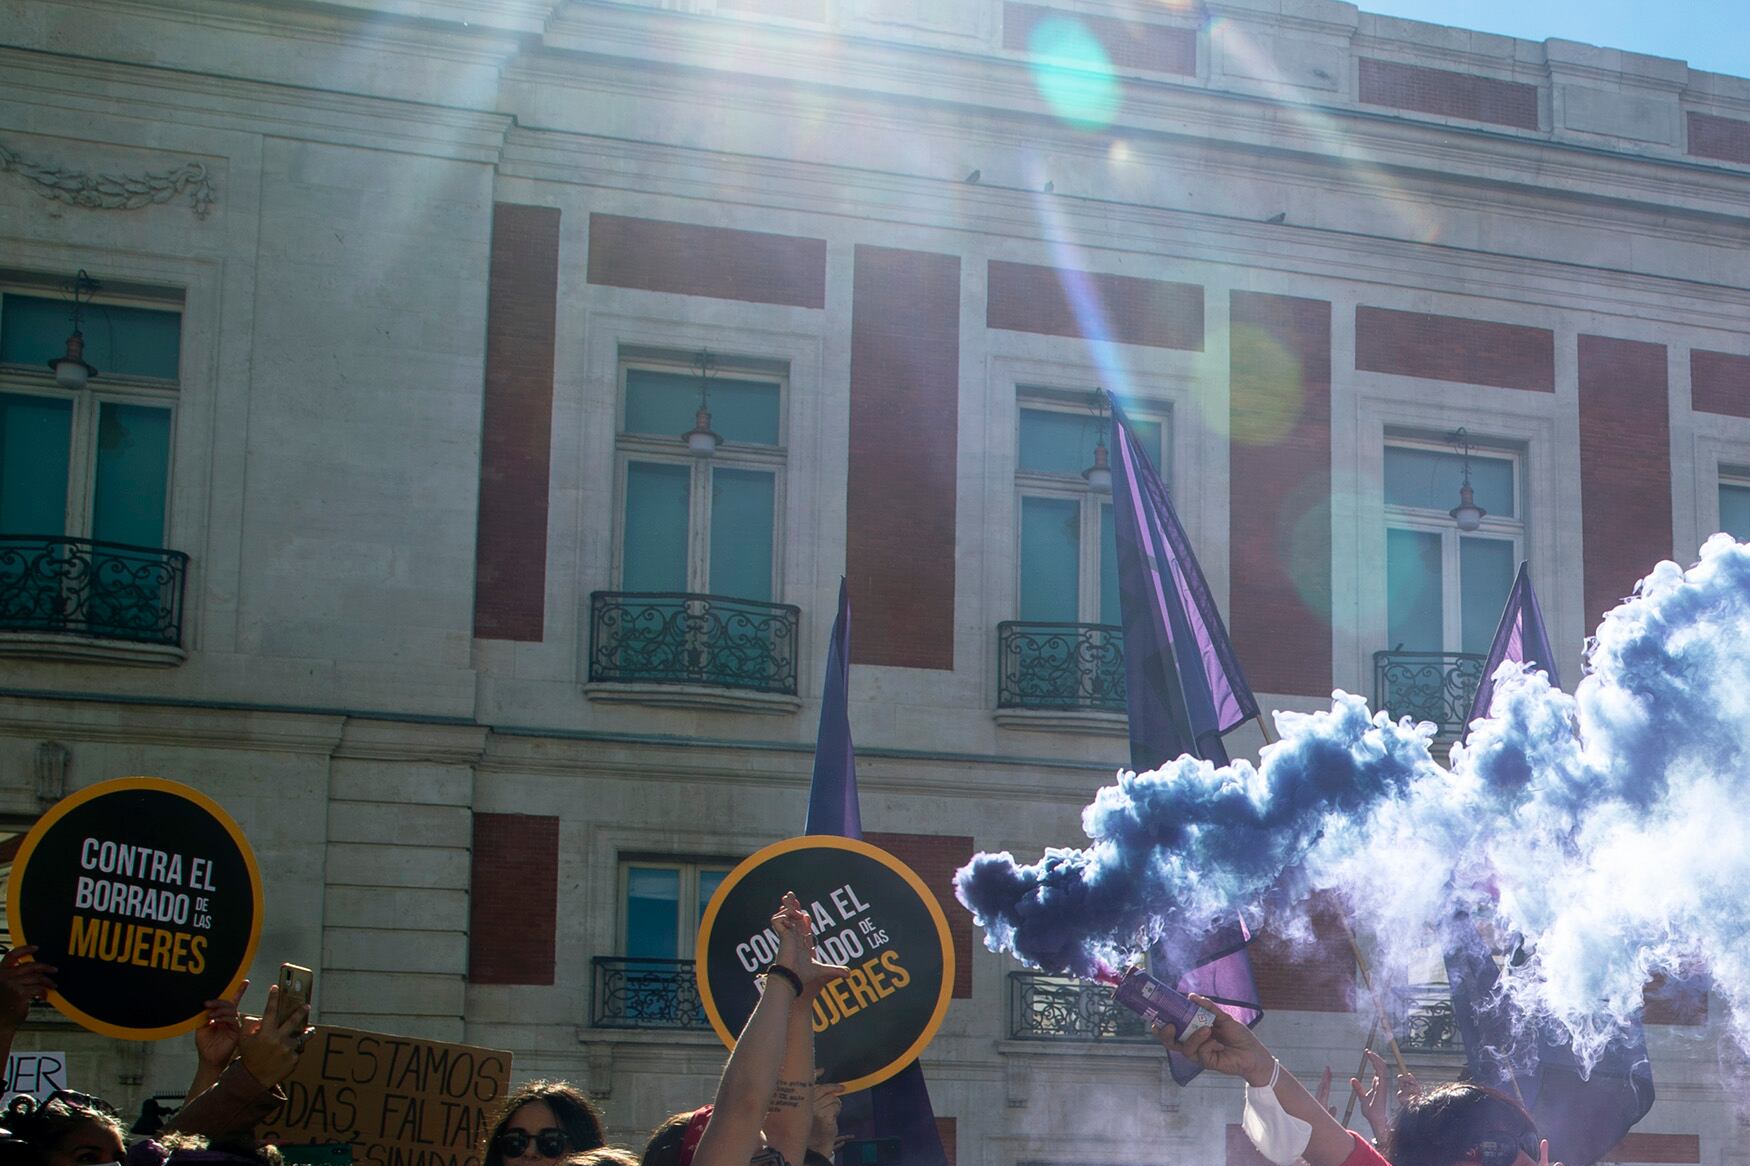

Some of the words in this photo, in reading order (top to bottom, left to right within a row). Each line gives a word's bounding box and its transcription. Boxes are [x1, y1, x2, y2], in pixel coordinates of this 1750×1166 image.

[81, 837, 182, 886] CONTRA
[190, 857, 216, 892] EL
[75, 876, 190, 925] BORRADO
[193, 913, 212, 929] LAS
[195, 896, 209, 912] DE
[829, 884, 870, 920] EL
[68, 915, 208, 975] MUJERES
[858, 917, 876, 936] DE
[867, 929, 889, 949] LAS
[811, 950, 911, 1033] UJERES
[321, 1033, 503, 1102] ESTAMOS
